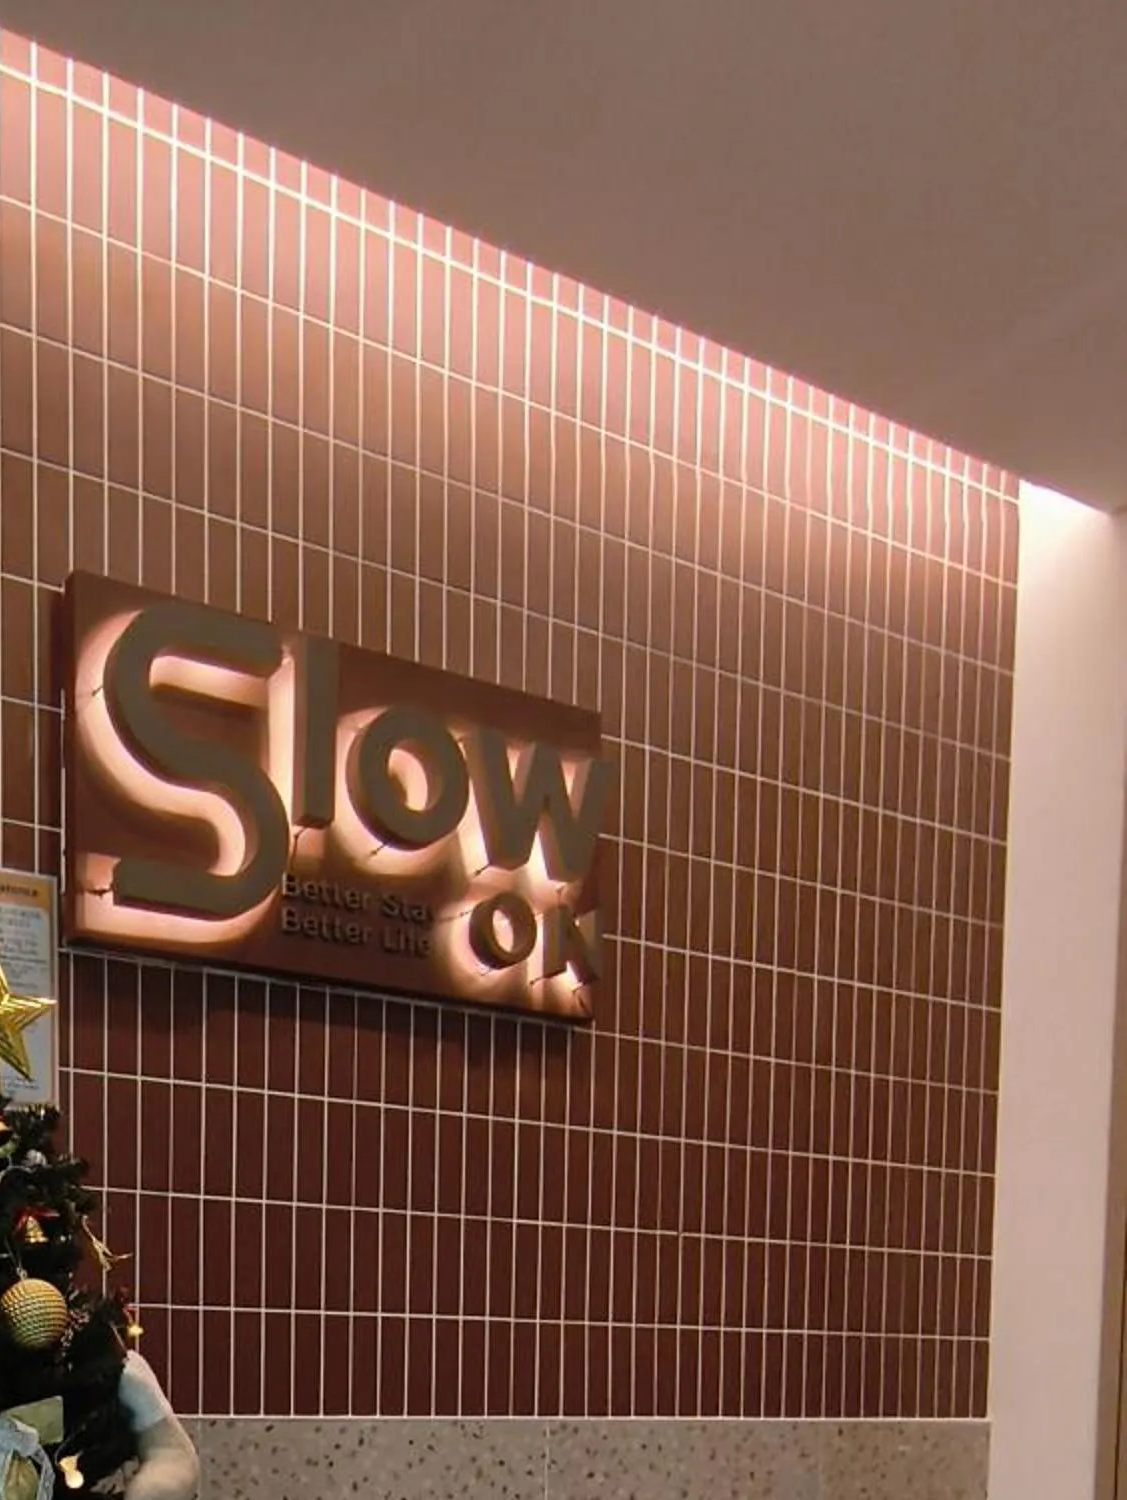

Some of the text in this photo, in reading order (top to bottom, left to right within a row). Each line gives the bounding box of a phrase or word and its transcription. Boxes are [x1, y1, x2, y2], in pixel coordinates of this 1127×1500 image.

[103, 604, 615, 918] Slow
[281, 871, 434, 922] Better Sta
[281, 907, 373, 945] Better
